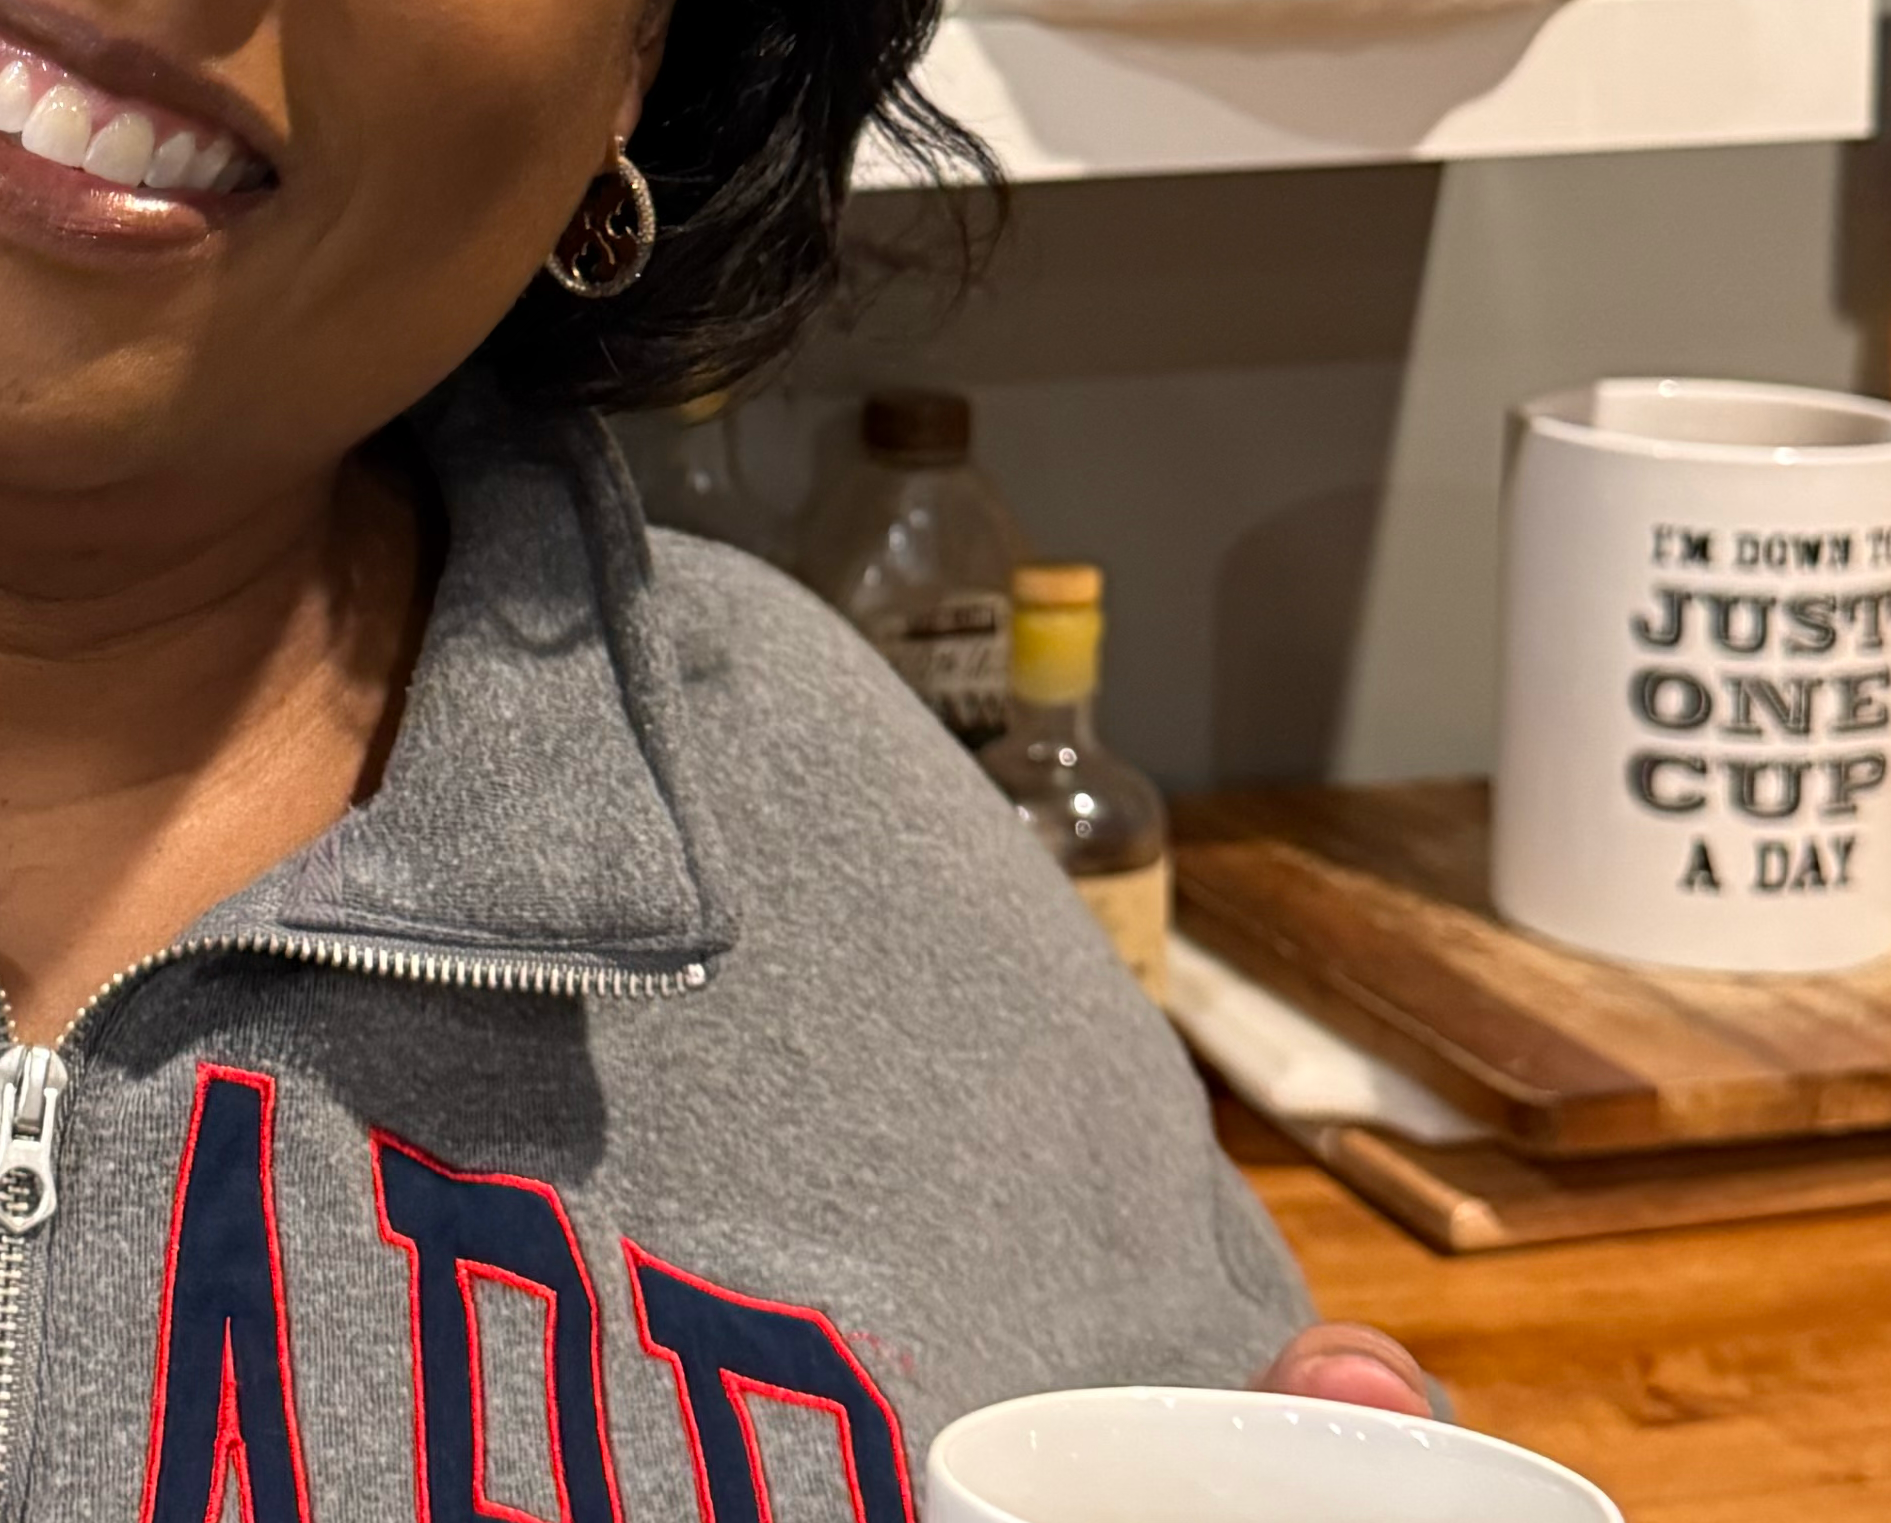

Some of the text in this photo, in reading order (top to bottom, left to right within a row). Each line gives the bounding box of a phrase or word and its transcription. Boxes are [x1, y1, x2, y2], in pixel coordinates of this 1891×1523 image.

[1651, 524, 1711, 569] I'M
[1735, 529, 1852, 570] DOWN
[1629, 583, 1891, 654] JUST
[1627, 665, 1891, 737] ONE
[1626, 751, 1887, 820] CUP
[1677, 835, 1858, 893] A DAY
